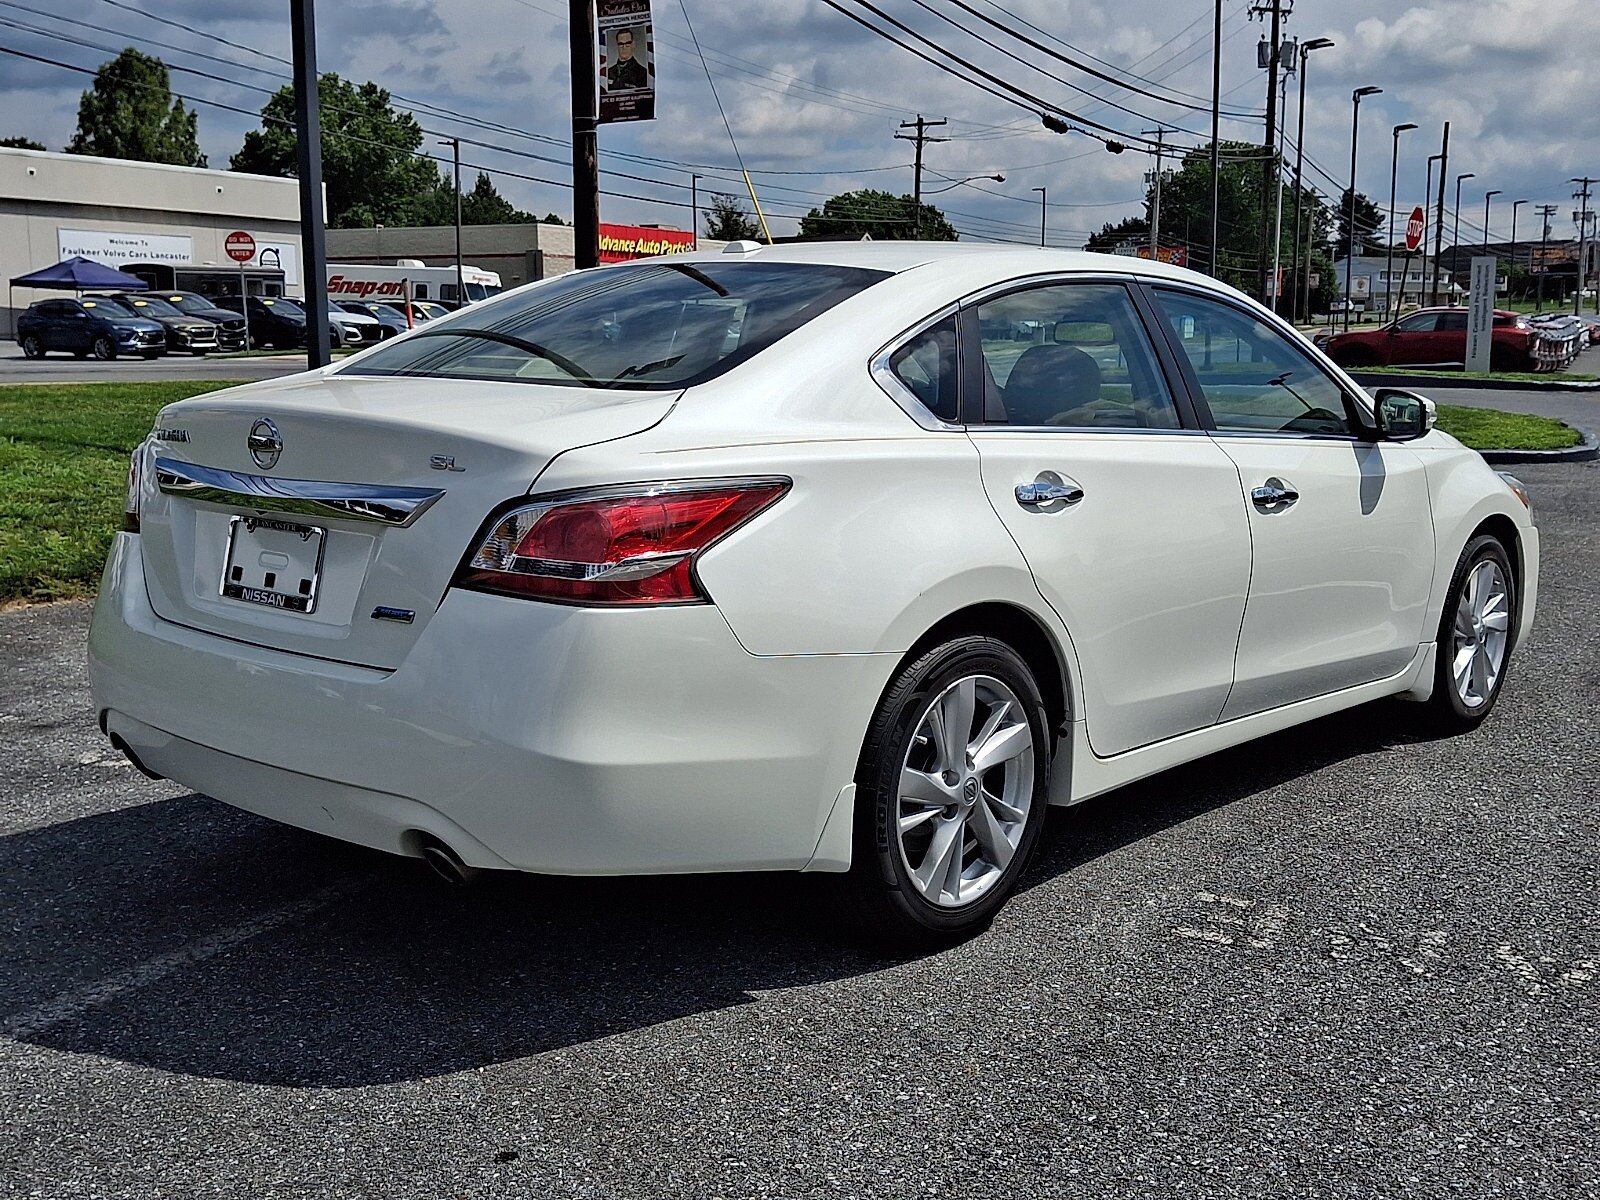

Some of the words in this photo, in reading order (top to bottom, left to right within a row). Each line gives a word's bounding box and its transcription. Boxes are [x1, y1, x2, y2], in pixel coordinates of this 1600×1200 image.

[1407, 219, 1424, 237] STOP
[109, 238, 138, 247] Welcome
[139, 239, 149, 247] To
[635, 238, 661, 255] Auto
[660, 240, 686, 256] Parts
[62, 247, 101, 257] Faulkner
[103, 249, 127, 258] Volvo
[128, 250, 148, 259] Cars
[150, 252, 191, 262] Lancaster
[326, 275, 404, 298] Snap-on
[1472, 304, 1480, 333] Certified
[431, 454, 466, 472] SL
[256, 520, 297, 532] LANCASTER
[242, 588, 286, 606] NISSAN
